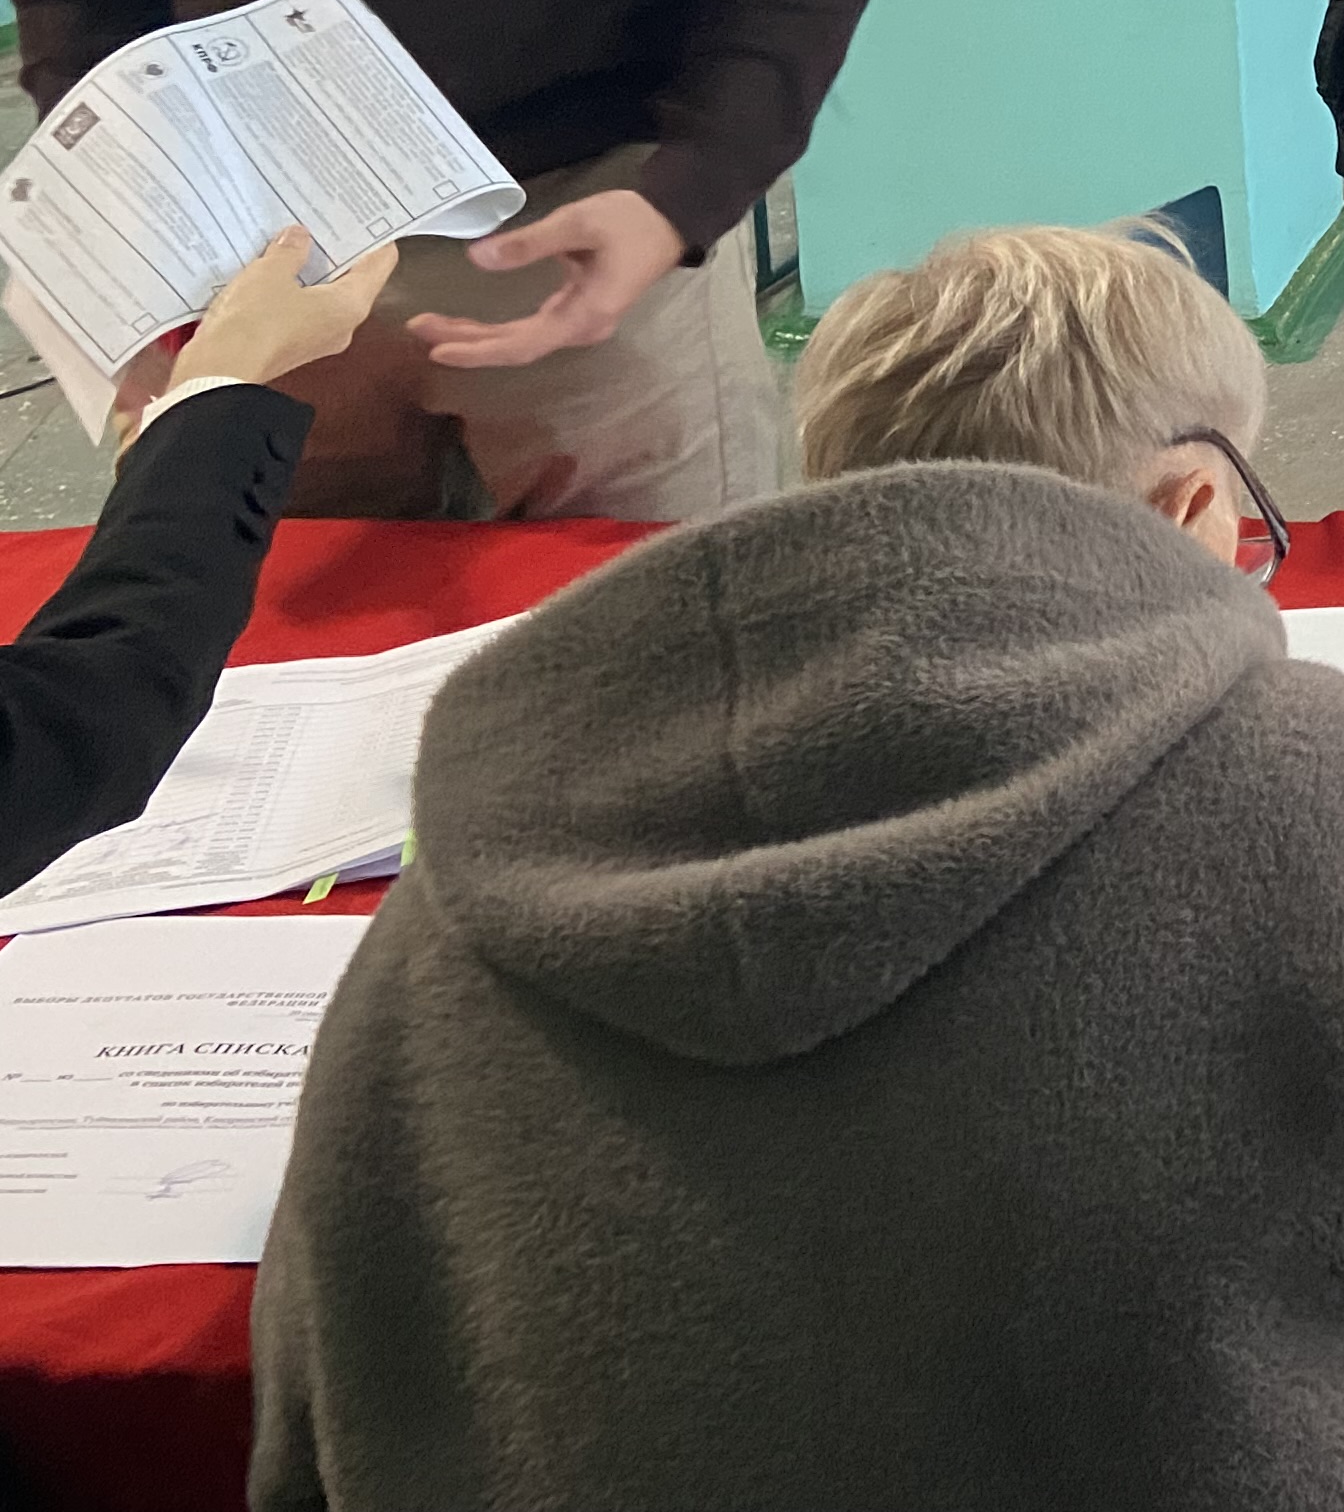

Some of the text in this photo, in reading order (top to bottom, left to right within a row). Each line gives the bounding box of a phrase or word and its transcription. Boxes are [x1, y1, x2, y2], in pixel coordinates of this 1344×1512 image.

[192, 44, 218, 73] КПРФ
[13, 991, 329, 1005] ВЫБОРЫ ДЕПУТАТОВ ГОСУДАРСТВЕННОЙ
[226, 1000, 320, 1008] ФЕДЕРАЦИИ
[94, 1041, 312, 1059] КНИГА СПИСКА
[141, 1080, 193, 1088] список
[194, 1078, 285, 1088] избирателей
